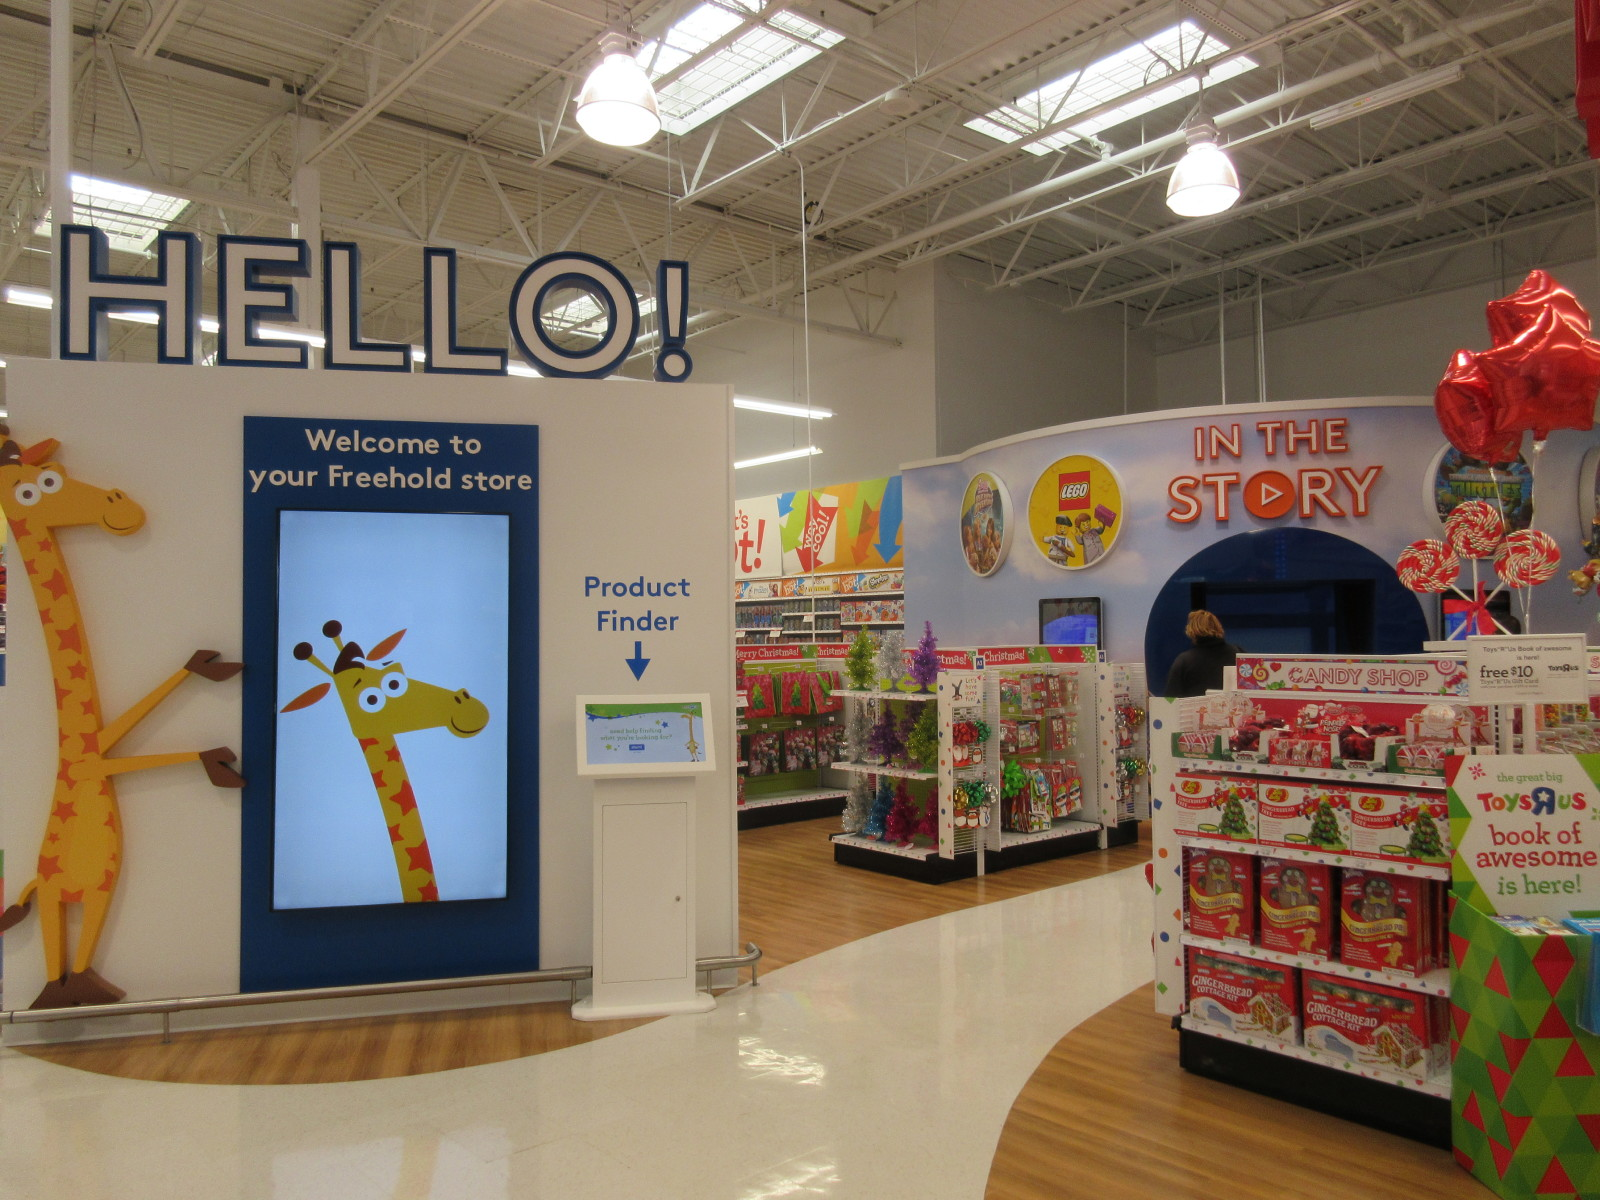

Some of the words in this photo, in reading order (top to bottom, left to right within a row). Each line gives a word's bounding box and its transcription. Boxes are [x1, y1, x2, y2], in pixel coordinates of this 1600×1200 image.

[60, 224, 692, 382] HELLO!
[304, 428, 440, 455] Welcome
[449, 435, 482, 456] to
[1194, 423, 1242, 461] IN
[1256, 418, 1349, 456] THE
[249, 469, 319, 493] your
[328, 464, 451, 489] Freehold
[461, 471, 533, 491] store
[1449, 481, 1521, 499] TURTLES
[1061, 482, 1090, 501] LEGO
[812, 510, 830, 552] cool!
[584, 575, 691, 598] Product
[597, 609, 680, 632] Finder
[758, 647, 799, 658] Christmas!
[983, 650, 1025, 662] Christmas!
[1288, 666, 1362, 685] CANDY
[1366, 668, 1429, 687] SHOP
[1480, 665, 1509, 678] free
[1510, 665, 1534, 678] $10
[1496, 771, 1514, 782] the
[1516, 773, 1544, 785] great
[1545, 771, 1563, 783] big
[1488, 821, 1551, 847] book
[1556, 820, 1583, 845] of
[1476, 849, 1598, 869] awesome
[1497, 875, 1518, 896] is
[1521, 872, 1583, 895] here!
[1191, 974, 1253, 998] GINGERBREAD
[1196, 985, 1225, 999] COTTAGE
[1226, 992, 1239, 1003] KIT
[1306, 1000, 1378, 1028] GINGERBREAD
[1311, 1013, 1347, 1028] COTTAGE
[1347, 1021, 1361, 1033] KIT
